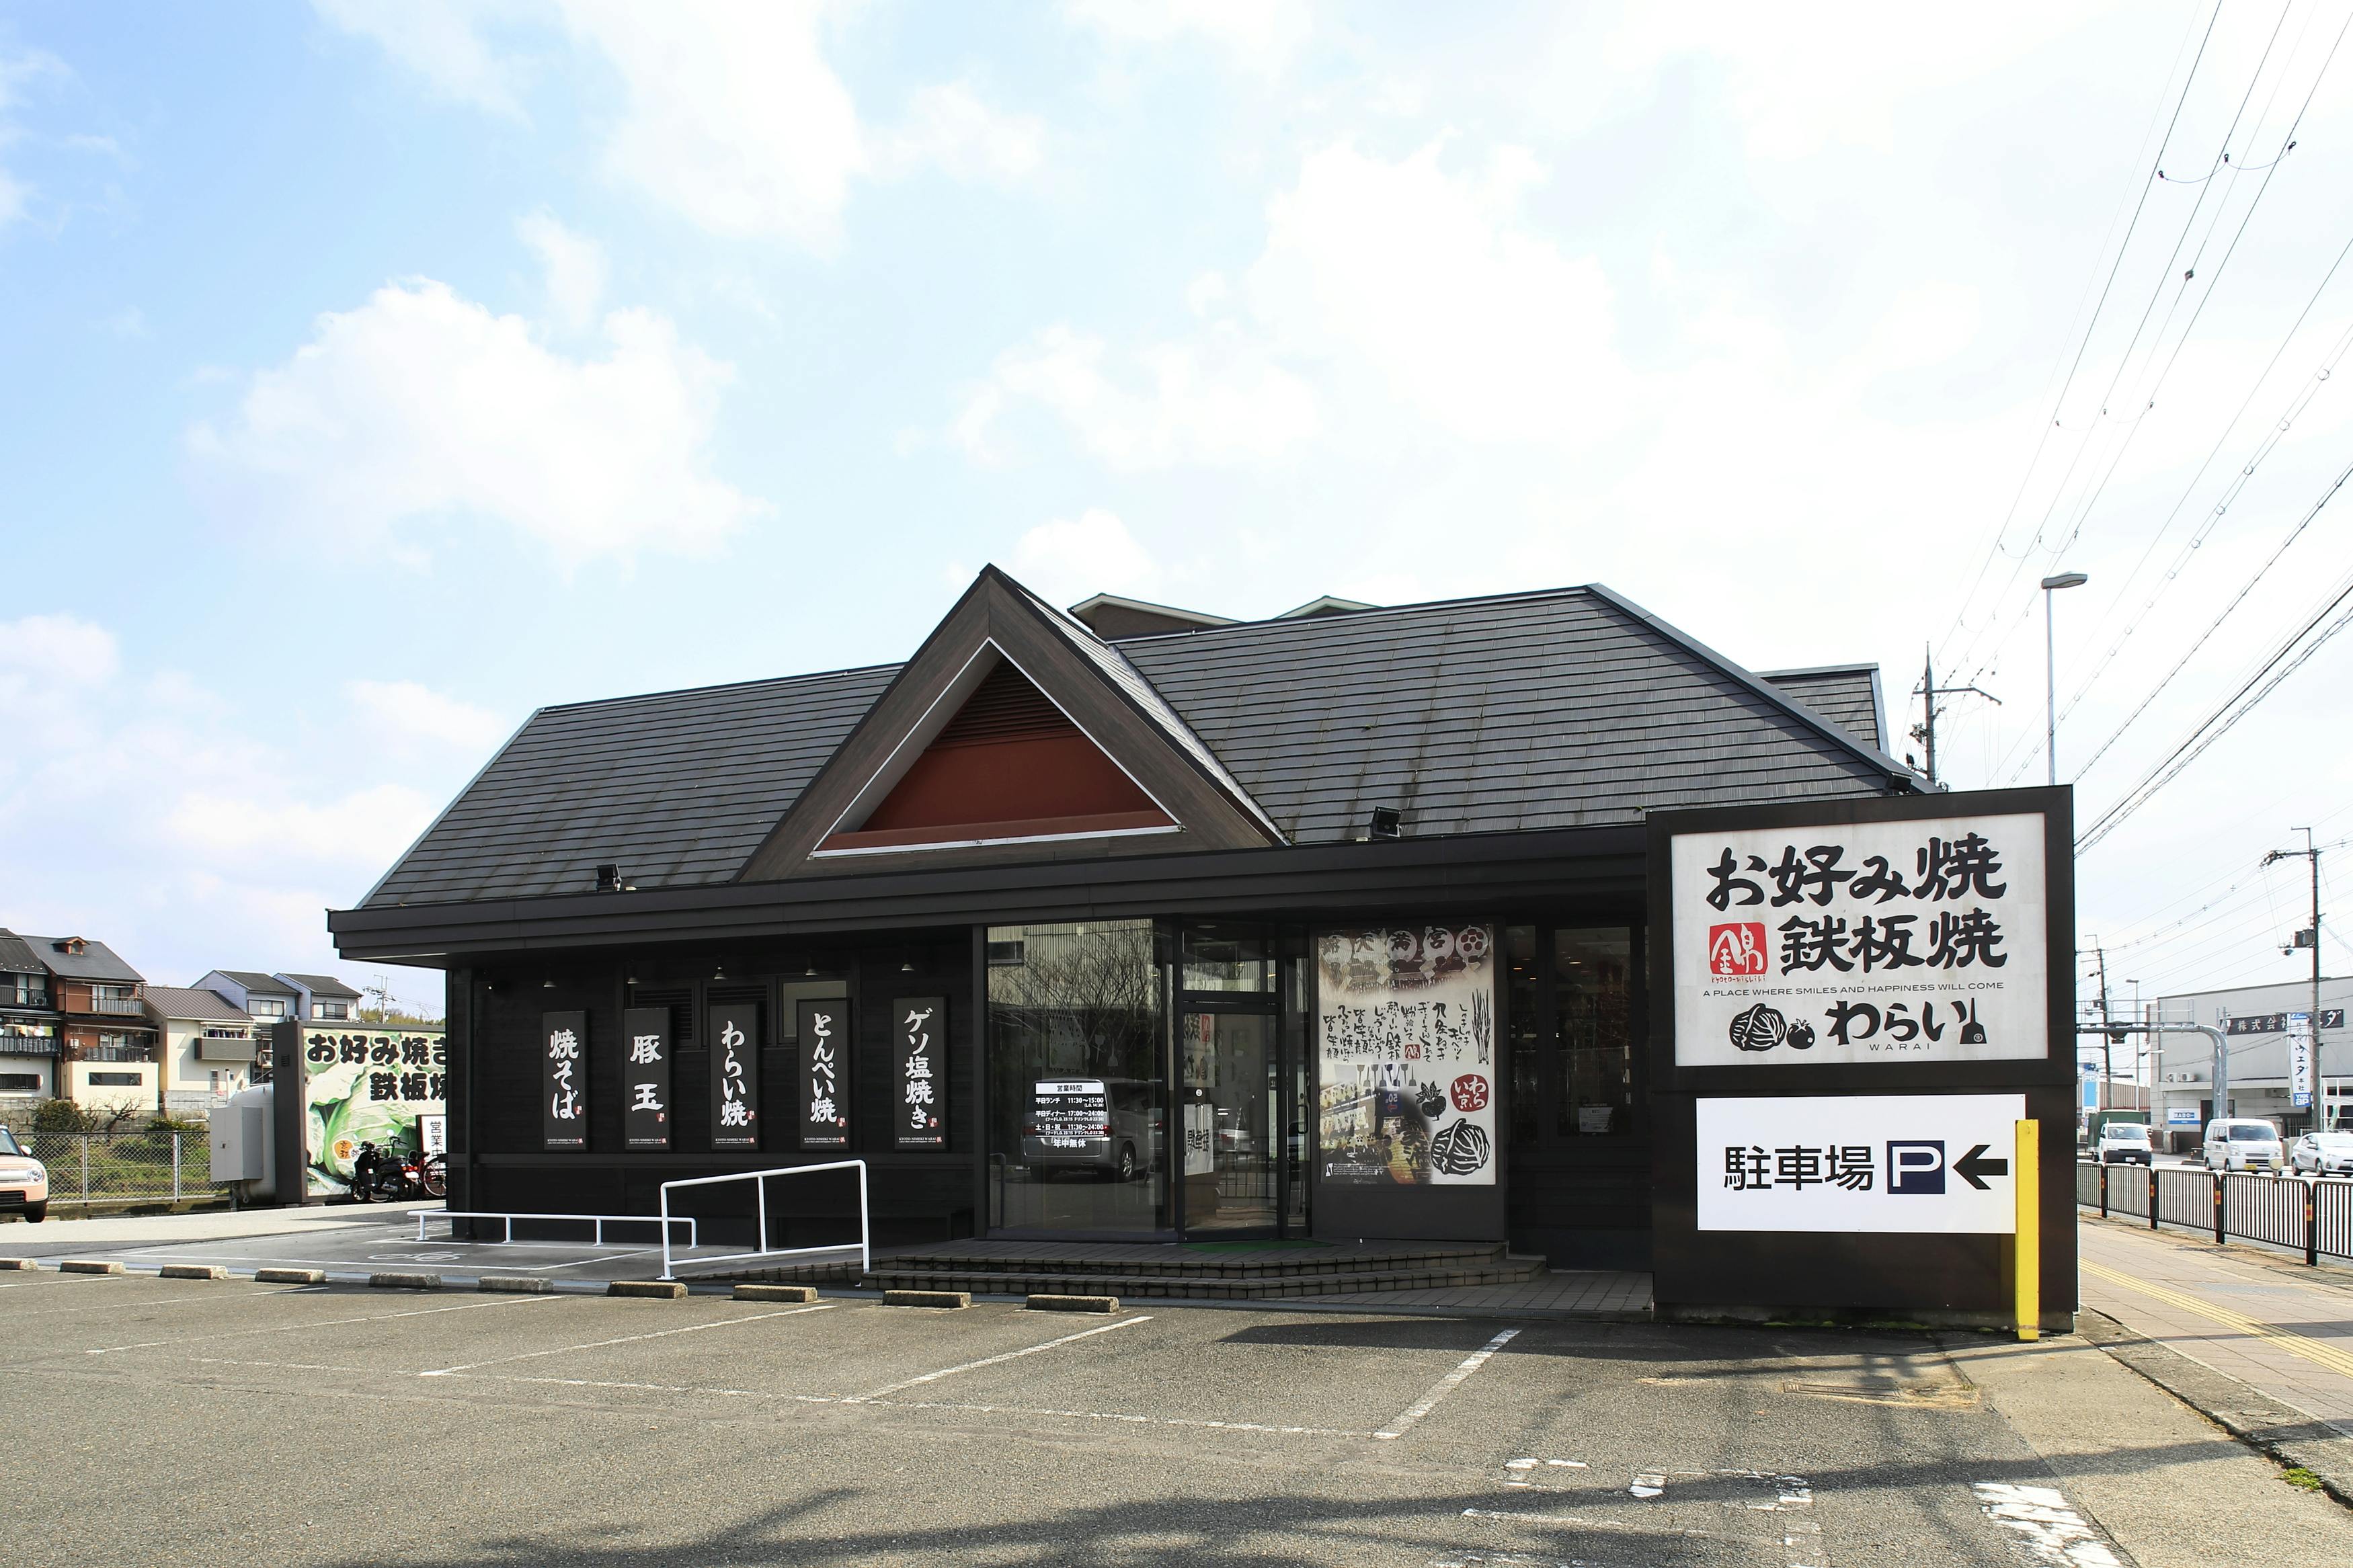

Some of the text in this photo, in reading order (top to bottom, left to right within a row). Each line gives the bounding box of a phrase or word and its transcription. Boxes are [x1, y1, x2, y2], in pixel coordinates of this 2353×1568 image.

[1706, 832, 2007, 911] お好み焼
[1777, 907, 2007, 976] 鉄板焼
[1825, 1000, 1967, 1046] わらい
[1868, 984, 1935, 993] HAPPINESS
[1968, 982, 2004, 990] COME
[549, 1028, 580, 1120] 焼そば
[629, 1035, 664, 1112] 豚玉
[721, 1020, 748, 1127] わらい焼
[810, 1012, 838, 1124] とんぺい焼
[904, 1007, 935, 1130] ゲソ塩焼き
[1869, 1043, 1929, 1051] WARAI
[1053, 1139, 1086, 1148] 年中無休
[1723, 1145, 1942, 1192] 駐車場 P
